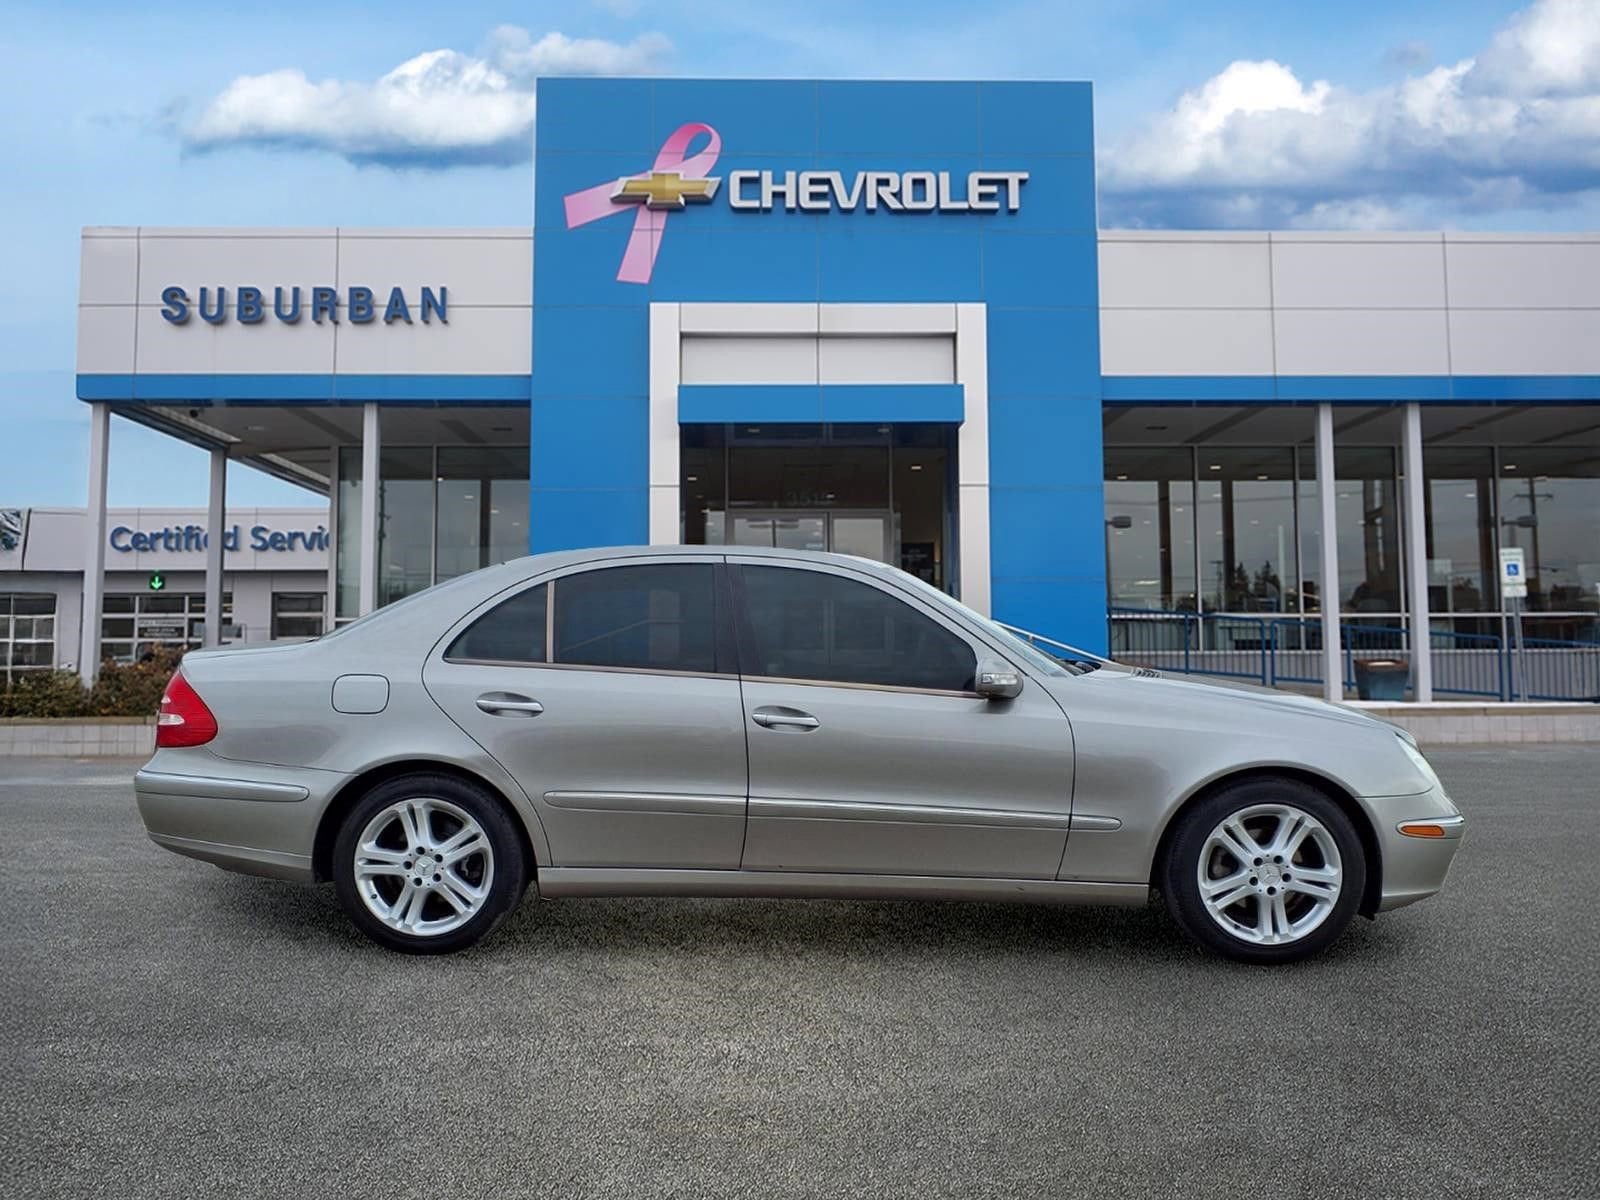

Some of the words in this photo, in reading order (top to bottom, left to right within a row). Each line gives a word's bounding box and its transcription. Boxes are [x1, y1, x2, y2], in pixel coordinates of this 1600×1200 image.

[729, 170, 1029, 212] CHEVROLET
[161, 286, 448, 324] SUBURBAN
[110, 525, 241, 552] Certifid
